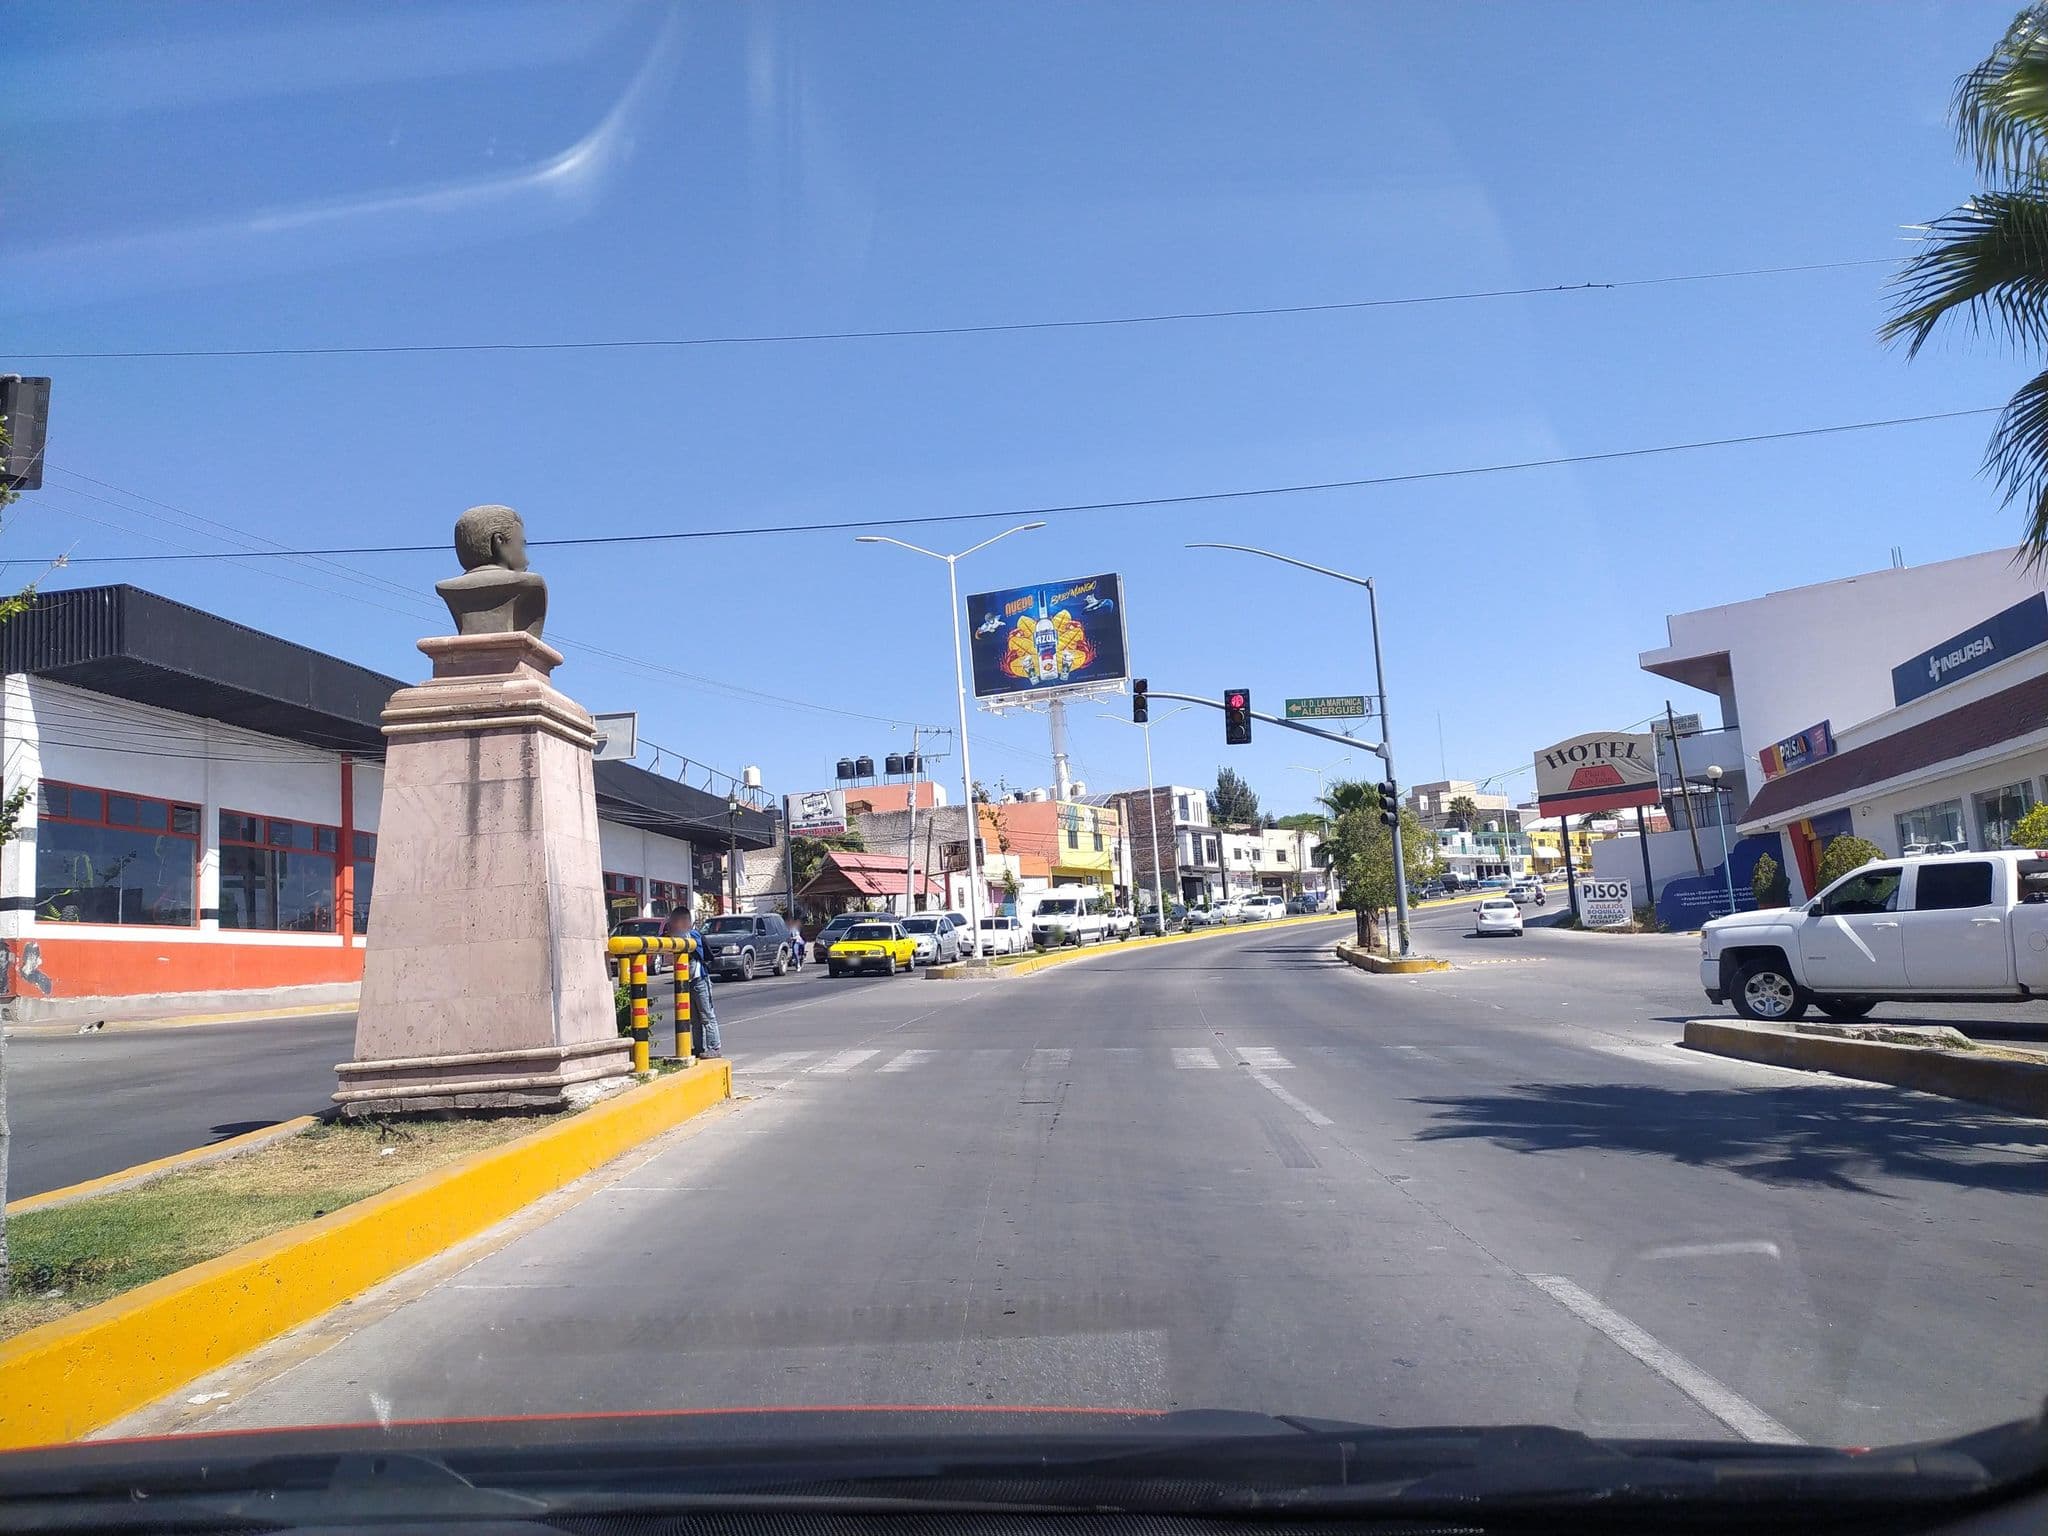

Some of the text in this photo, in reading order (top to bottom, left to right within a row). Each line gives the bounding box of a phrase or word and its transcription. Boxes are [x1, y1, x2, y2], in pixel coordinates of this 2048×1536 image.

[1036, 634, 1057, 645] AZUL
[1940, 635, 1995, 672] INBURSA
[1317, 699, 1326, 707] LA
[1326, 697, 1362, 707] MARTINICA
[1301, 705, 1363, 715] ALBERGUES
[1544, 741, 1641, 770] HOTEL
[1583, 883, 1628, 899] PISOS
